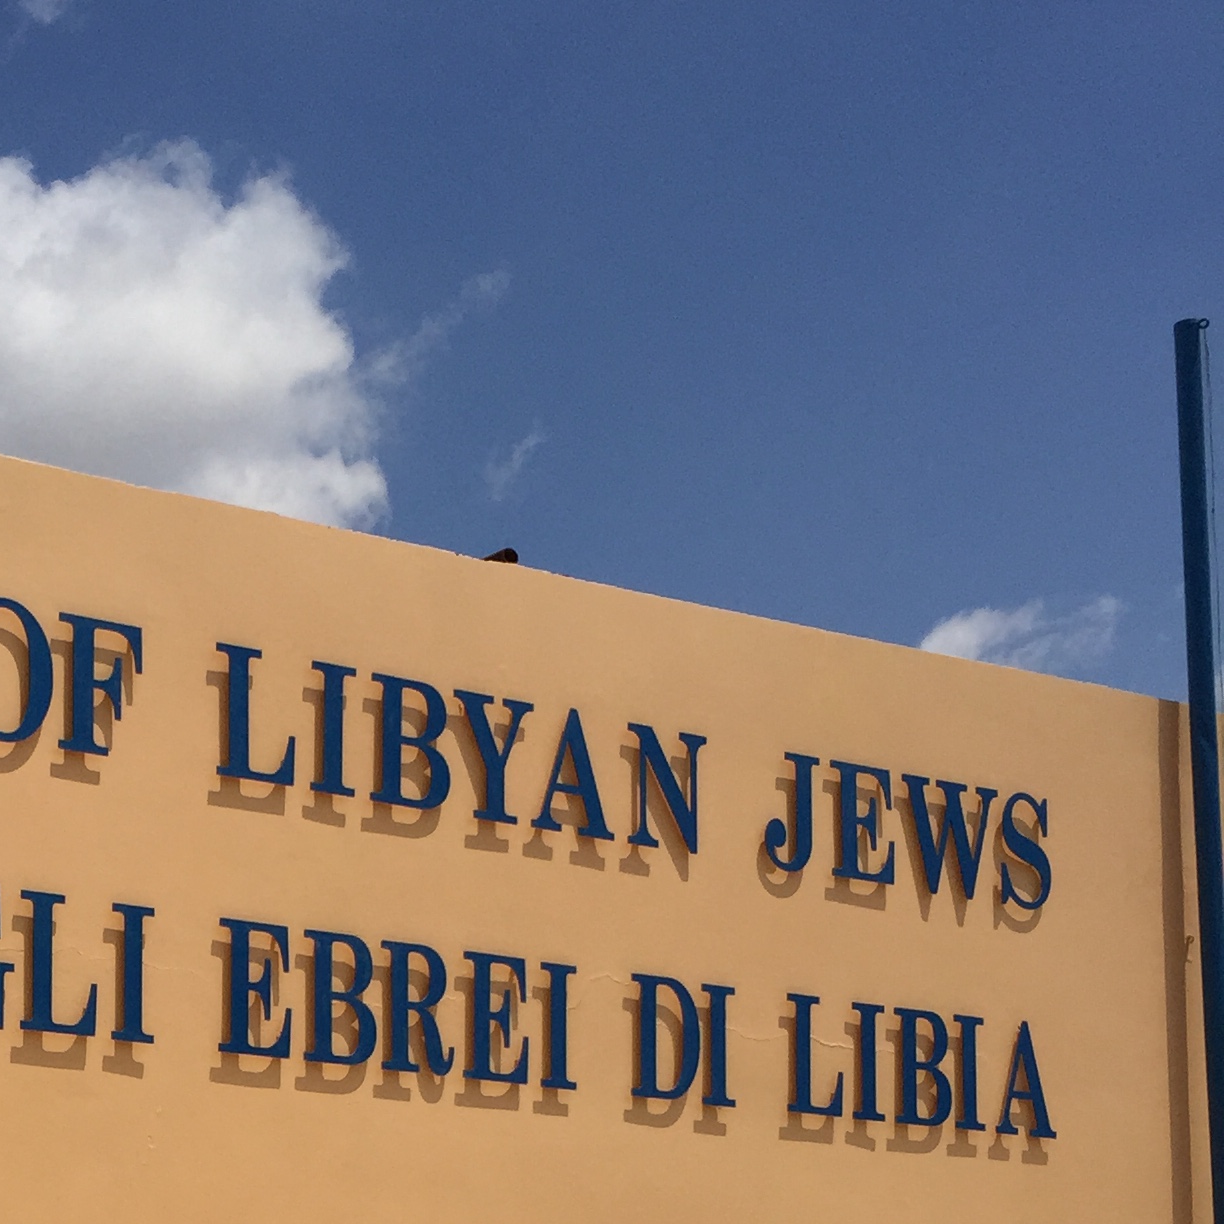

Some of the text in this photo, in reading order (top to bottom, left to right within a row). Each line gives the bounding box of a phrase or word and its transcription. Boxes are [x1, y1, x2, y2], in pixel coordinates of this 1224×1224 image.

[216, 643, 707, 855] LIBYAN
[763, 753, 1052, 910] JEWS
[218, 918, 577, 1091] EBREI
[632, 973, 736, 1109] DI
[787, 994, 1057, 1139] LIBIA
